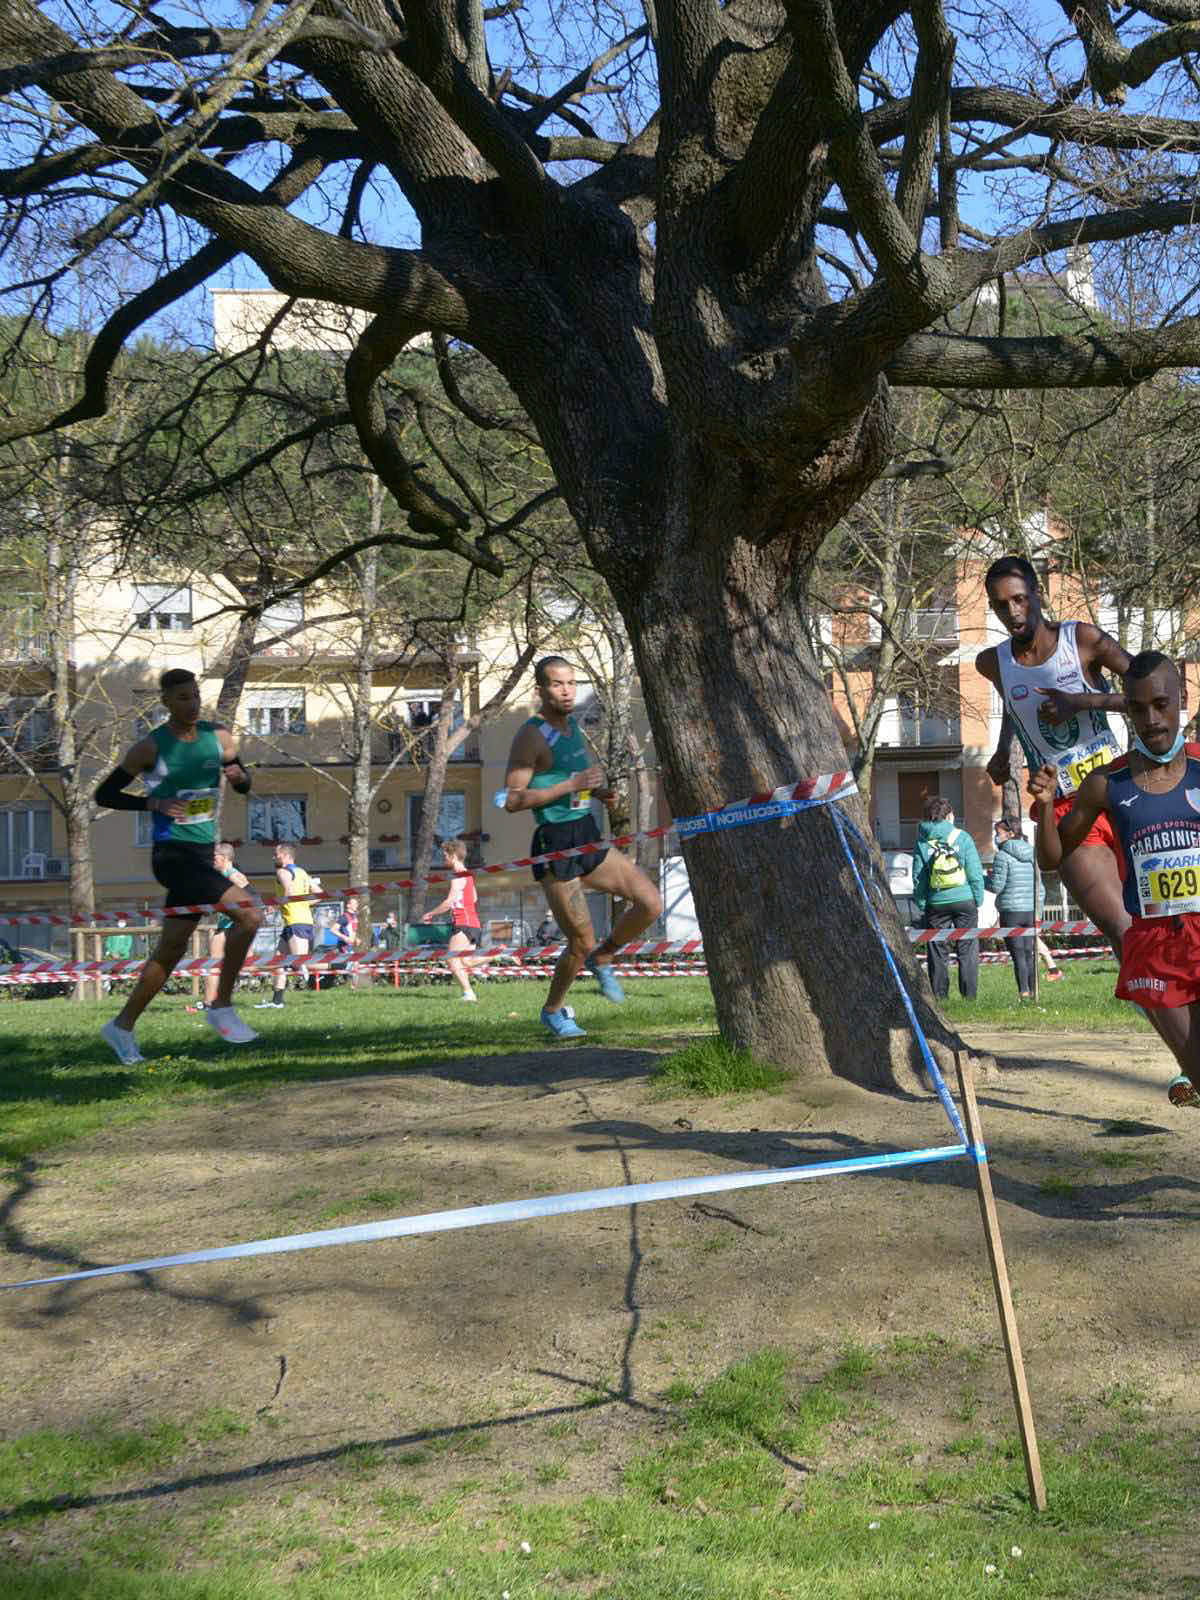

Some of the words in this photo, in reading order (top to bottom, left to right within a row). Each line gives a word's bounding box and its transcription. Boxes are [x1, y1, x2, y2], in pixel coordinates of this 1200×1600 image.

[1077, 735, 1113, 760] KARHU
[1076, 752, 1104, 783] 677
[1158, 869, 1198, 899] 629
